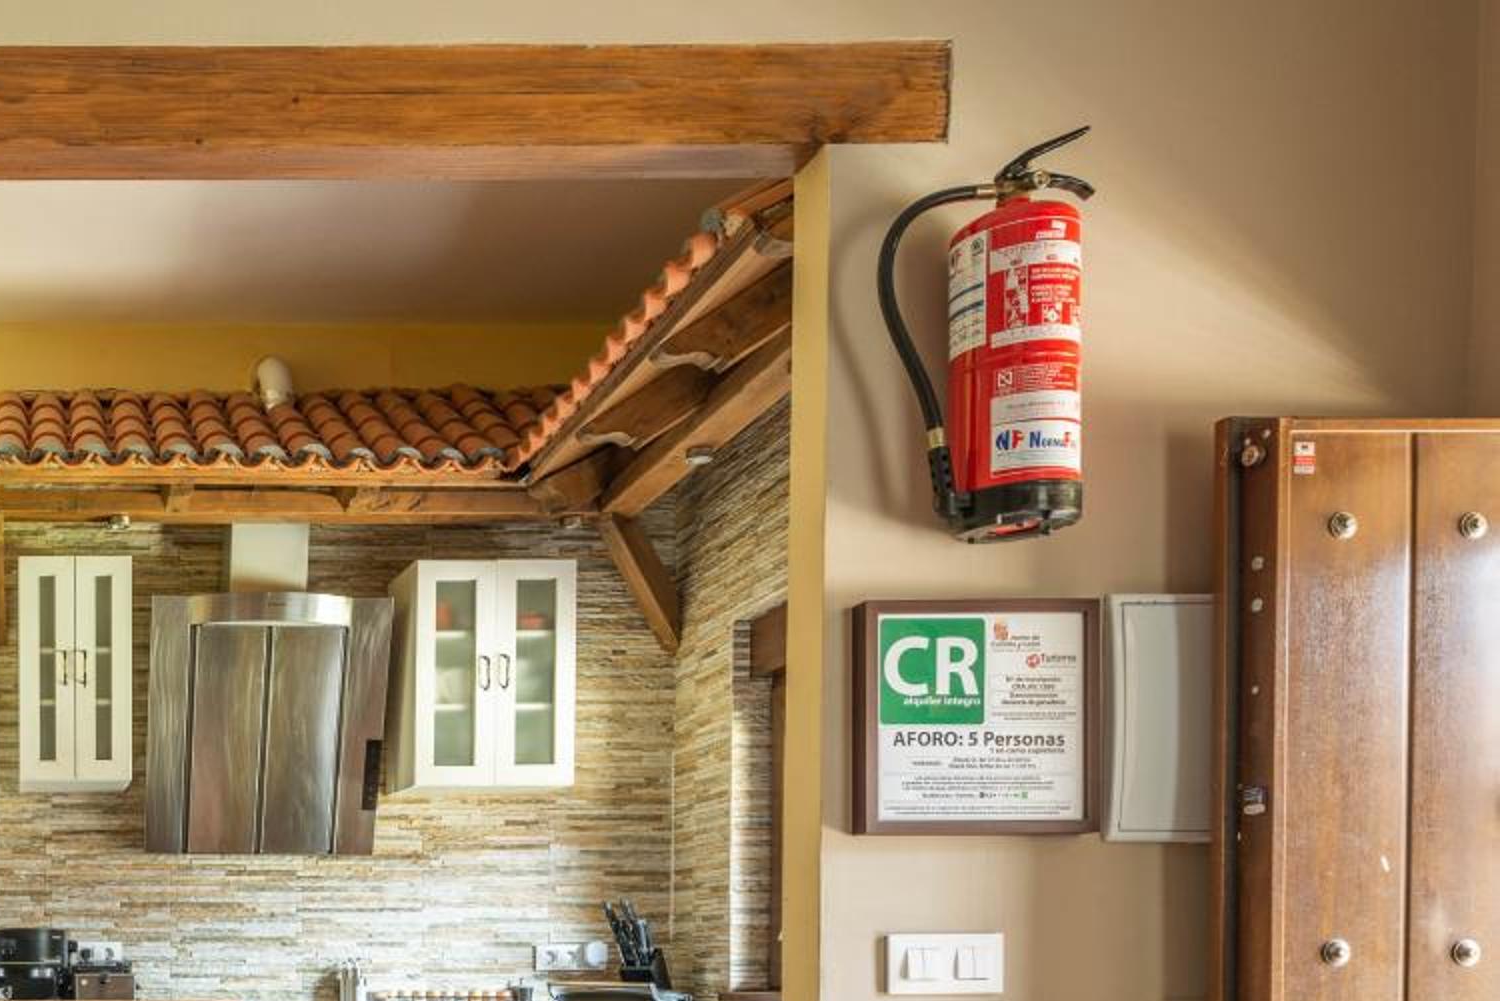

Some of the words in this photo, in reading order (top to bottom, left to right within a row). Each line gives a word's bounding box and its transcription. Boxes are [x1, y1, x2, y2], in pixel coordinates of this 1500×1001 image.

[884, 636, 979, 697] CR
[893, 732, 963, 747] AFORO:
[968, 732, 978, 747] 5
[984, 732, 1066, 747] Personas
